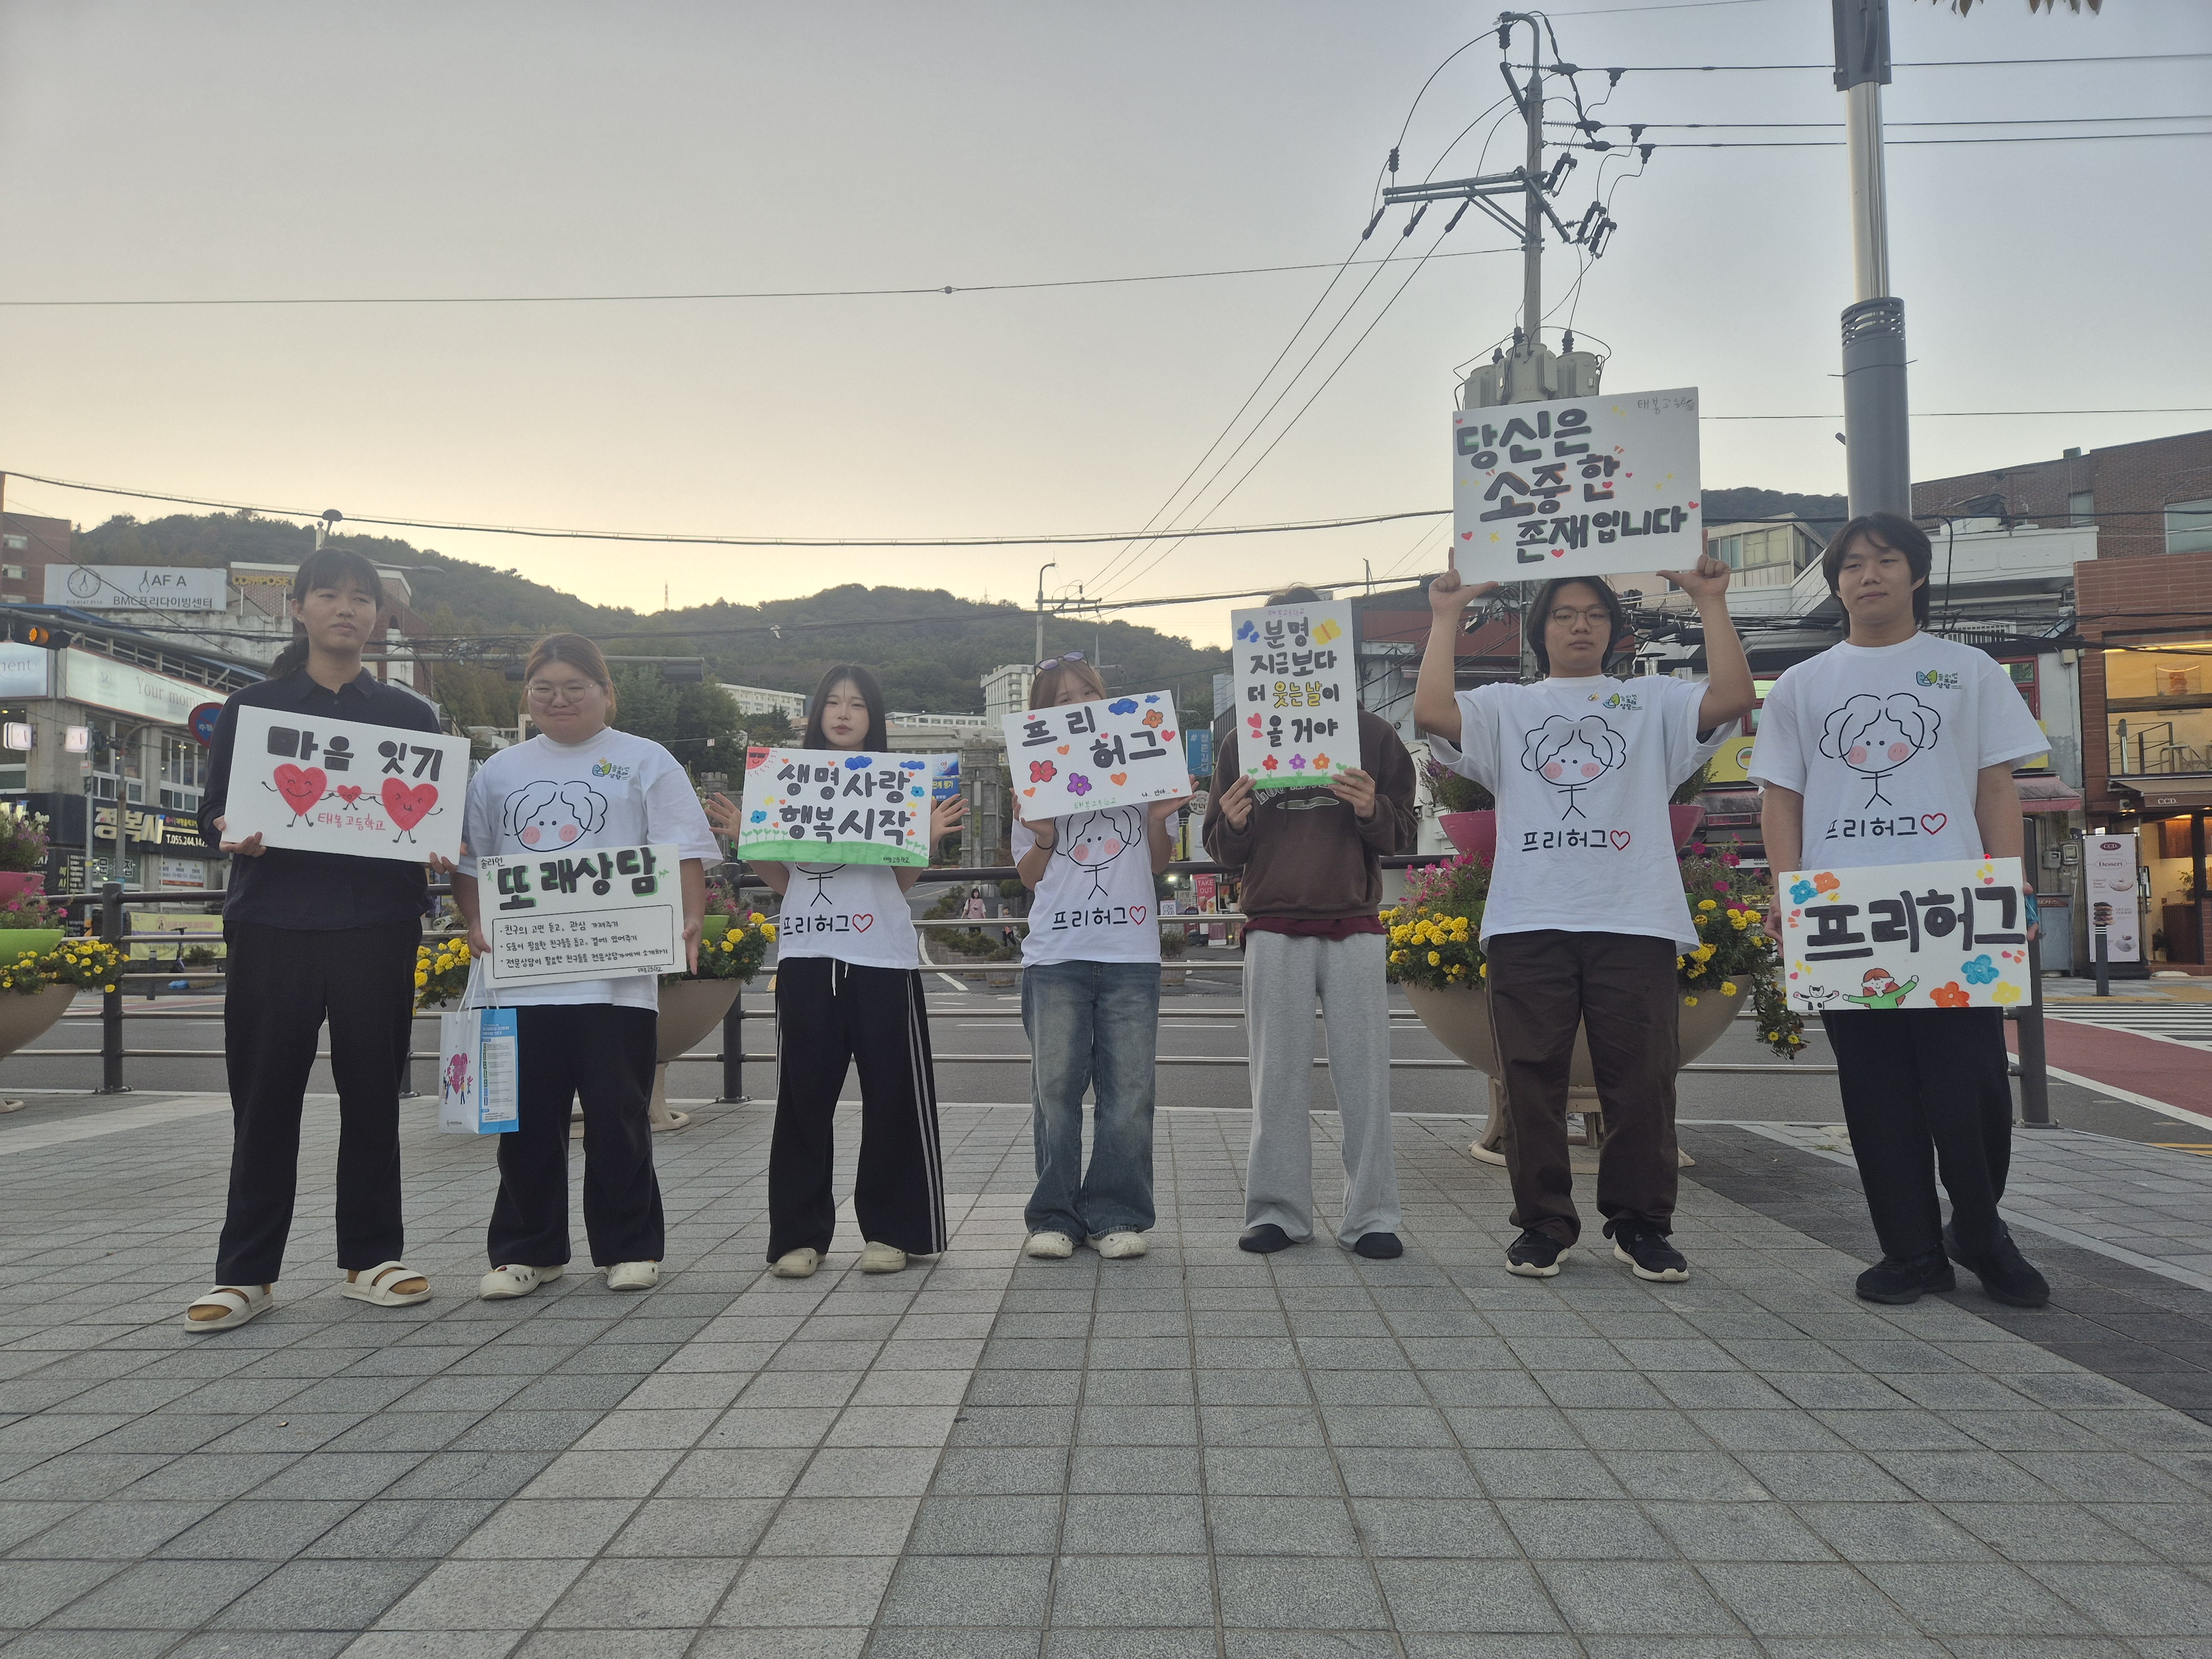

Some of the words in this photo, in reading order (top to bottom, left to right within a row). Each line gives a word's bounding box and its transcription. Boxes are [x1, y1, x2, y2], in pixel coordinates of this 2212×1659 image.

[1456, 408, 1592, 469] 당신은
[1480, 453, 1621, 522] 소중한
[1516, 505, 1689, 564] 존재입니다
[232, 576, 289, 586] COMPOSE
[113, 596, 212, 608] BMC프리다이빙센터
[1264, 617, 1309, 649] 분명
[1250, 650, 1337, 676] 지금보다
[136, 676, 164, 700] Your
[1248, 684, 1265, 702] 더
[267, 726, 354, 771] 마음
[378, 740, 444, 782] 잇기
[1089, 731, 1167, 768] 허그
[166, 834, 208, 848] T.055.244.142
[1522, 828, 1608, 852] 프리허그
[481, 857, 505, 869] 솔리언
[505, 925, 528, 935] 친구의
[531, 925, 544, 933] 고민
[570, 921, 586, 932] 관심
[783, 914, 850, 936] 프리허그
[1052, 907, 1128, 930] 프리허그
[1805, 886, 2026, 962] 프리허그
[506, 942, 524, 951] 도움이
[528, 941, 547, 951] 필요한
[550, 938, 571, 948] 친구들을
[591, 937, 607, 946] 곁에
[611, 935, 637, 943] 있어주기
[506, 958, 541, 968] 전문상담이
[545, 955, 563, 966] 필요한
[566, 953, 588, 963] 친구들을
